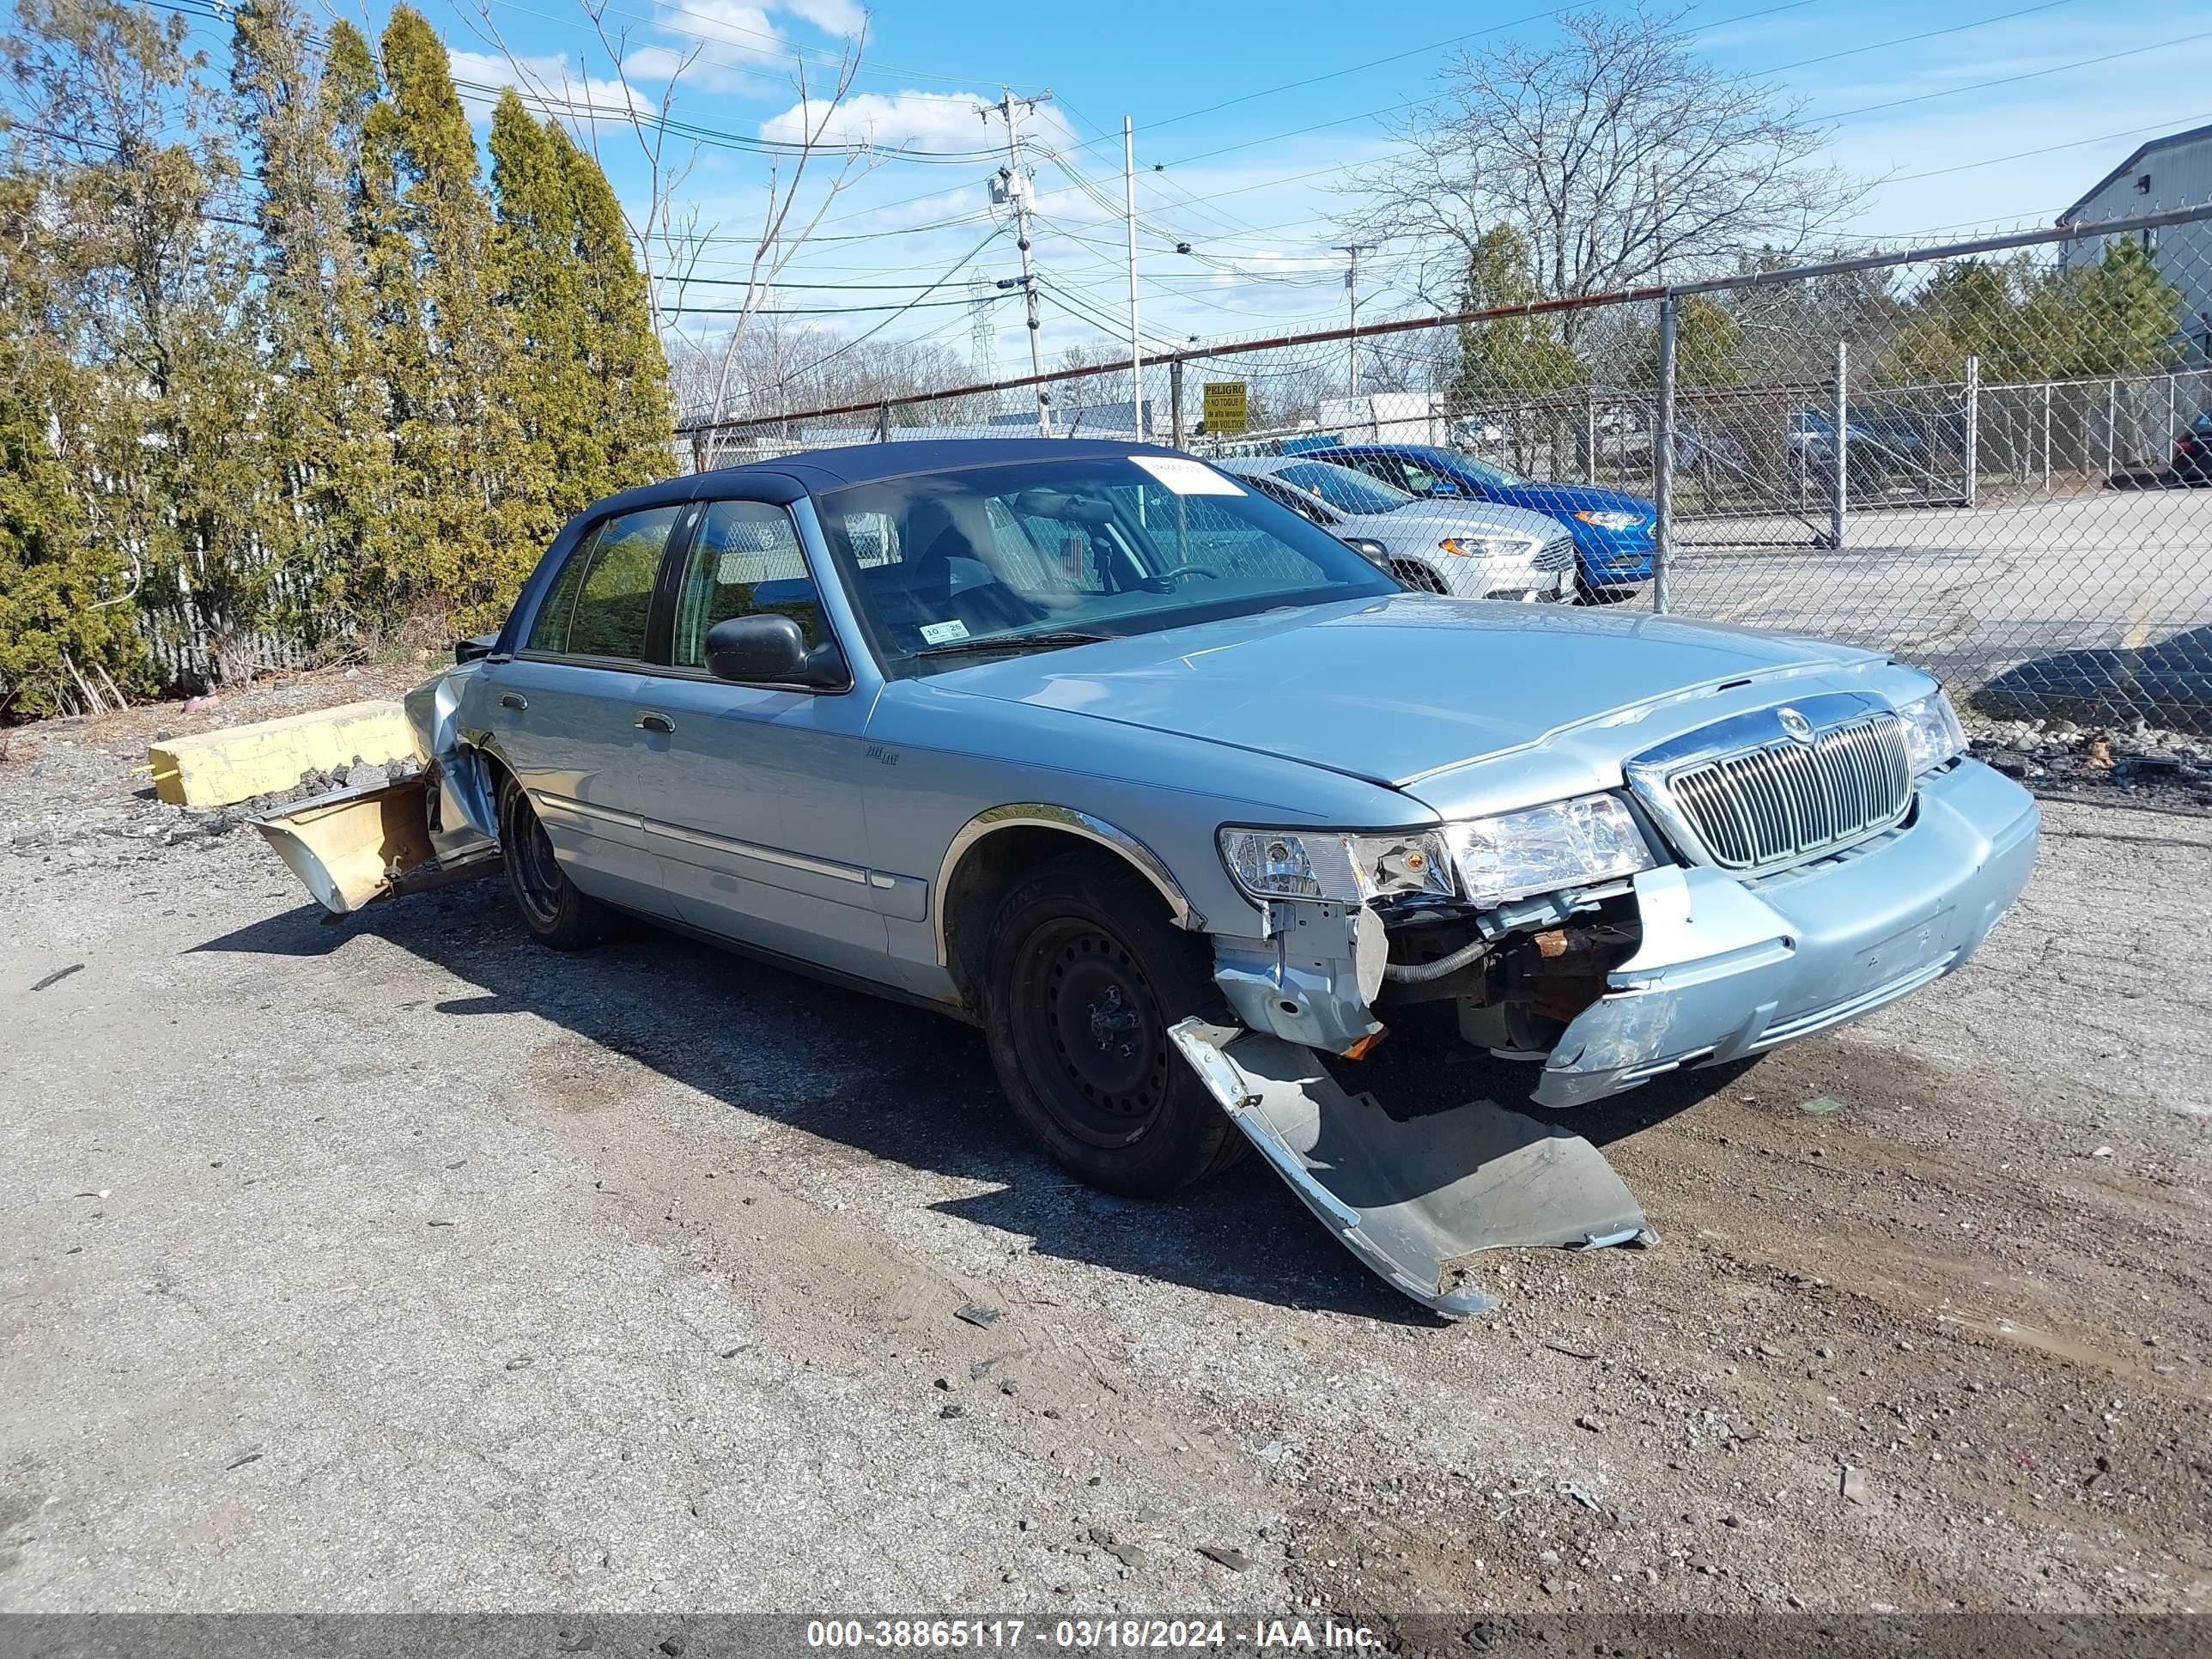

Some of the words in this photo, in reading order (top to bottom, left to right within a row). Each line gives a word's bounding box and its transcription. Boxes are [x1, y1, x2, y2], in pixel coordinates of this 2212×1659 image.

[1206, 385, 1245, 395] PELIGRO
[1220, 398, 1239, 407] TOQUE
[1219, 420, 1245, 428] VOLTIOS
